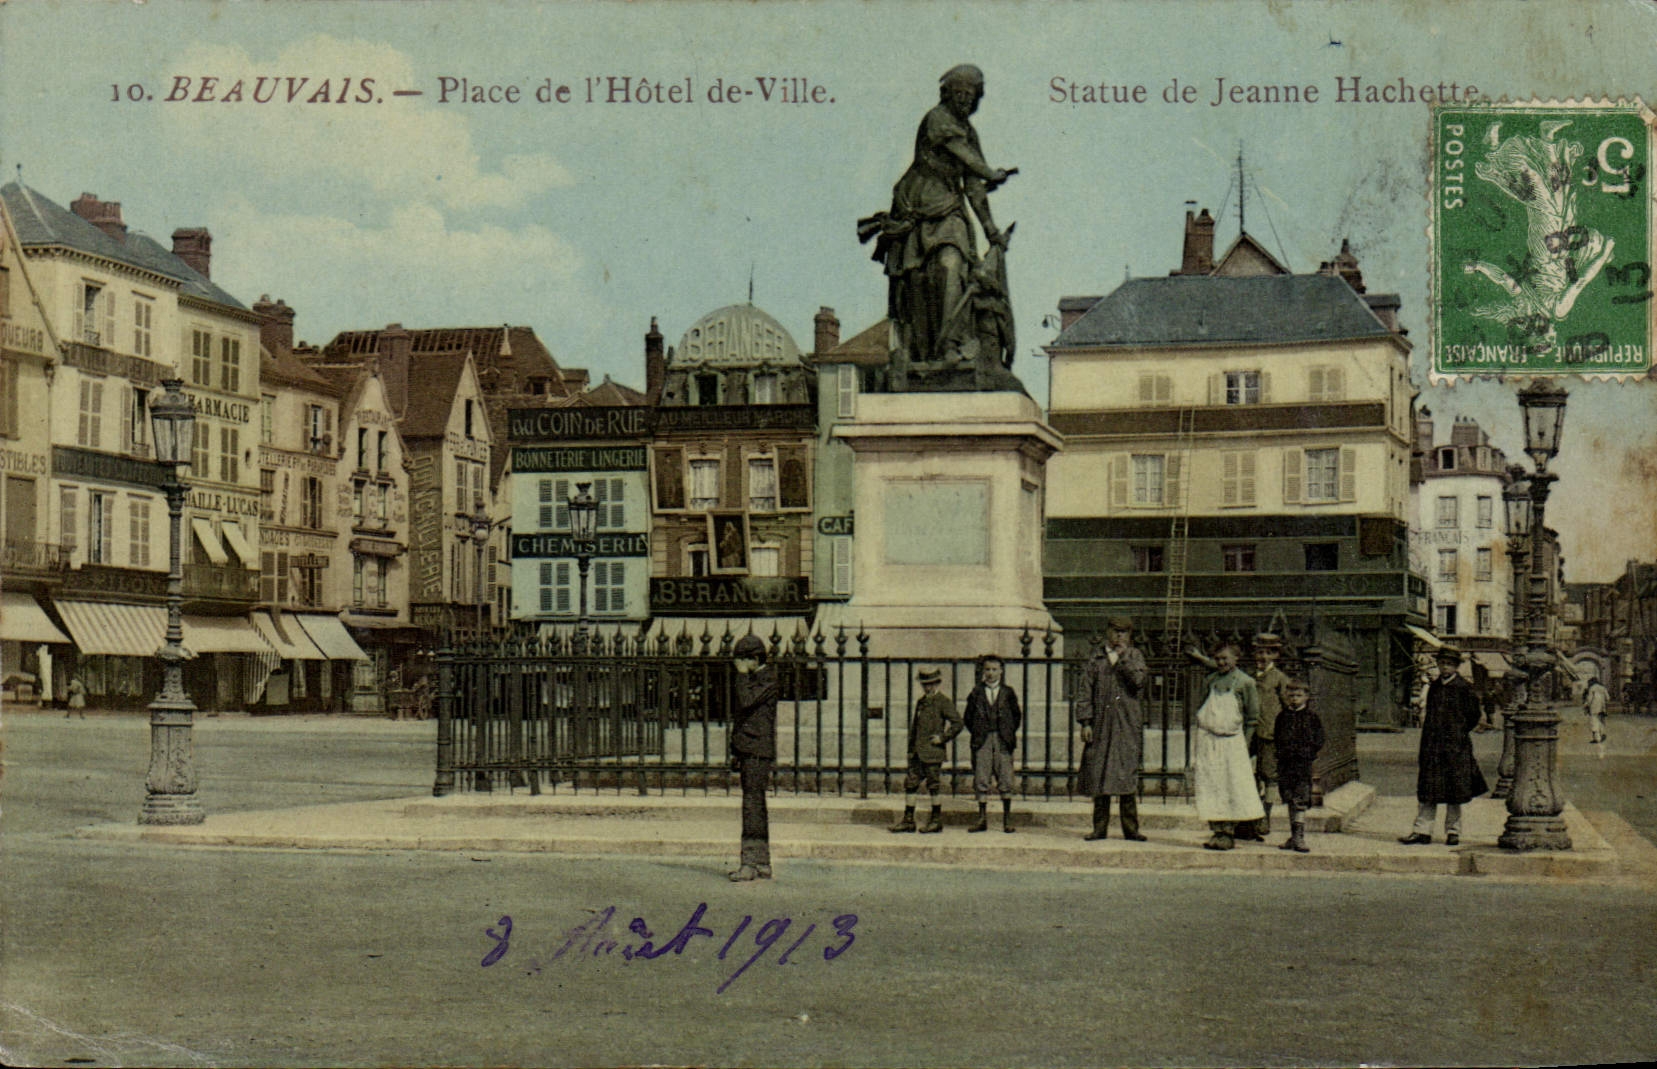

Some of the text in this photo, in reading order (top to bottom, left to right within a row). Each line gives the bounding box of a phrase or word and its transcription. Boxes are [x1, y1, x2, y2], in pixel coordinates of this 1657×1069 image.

[1445, 123, 1464, 211] POSTES
[1554, 343, 1643, 363] REPUBQUE
[536, 412, 583, 436] COIN
[607, 410, 646, 434] RUE
[592, 448, 645, 467] LINGERIE
[716, 914, 859, 996] 1913
